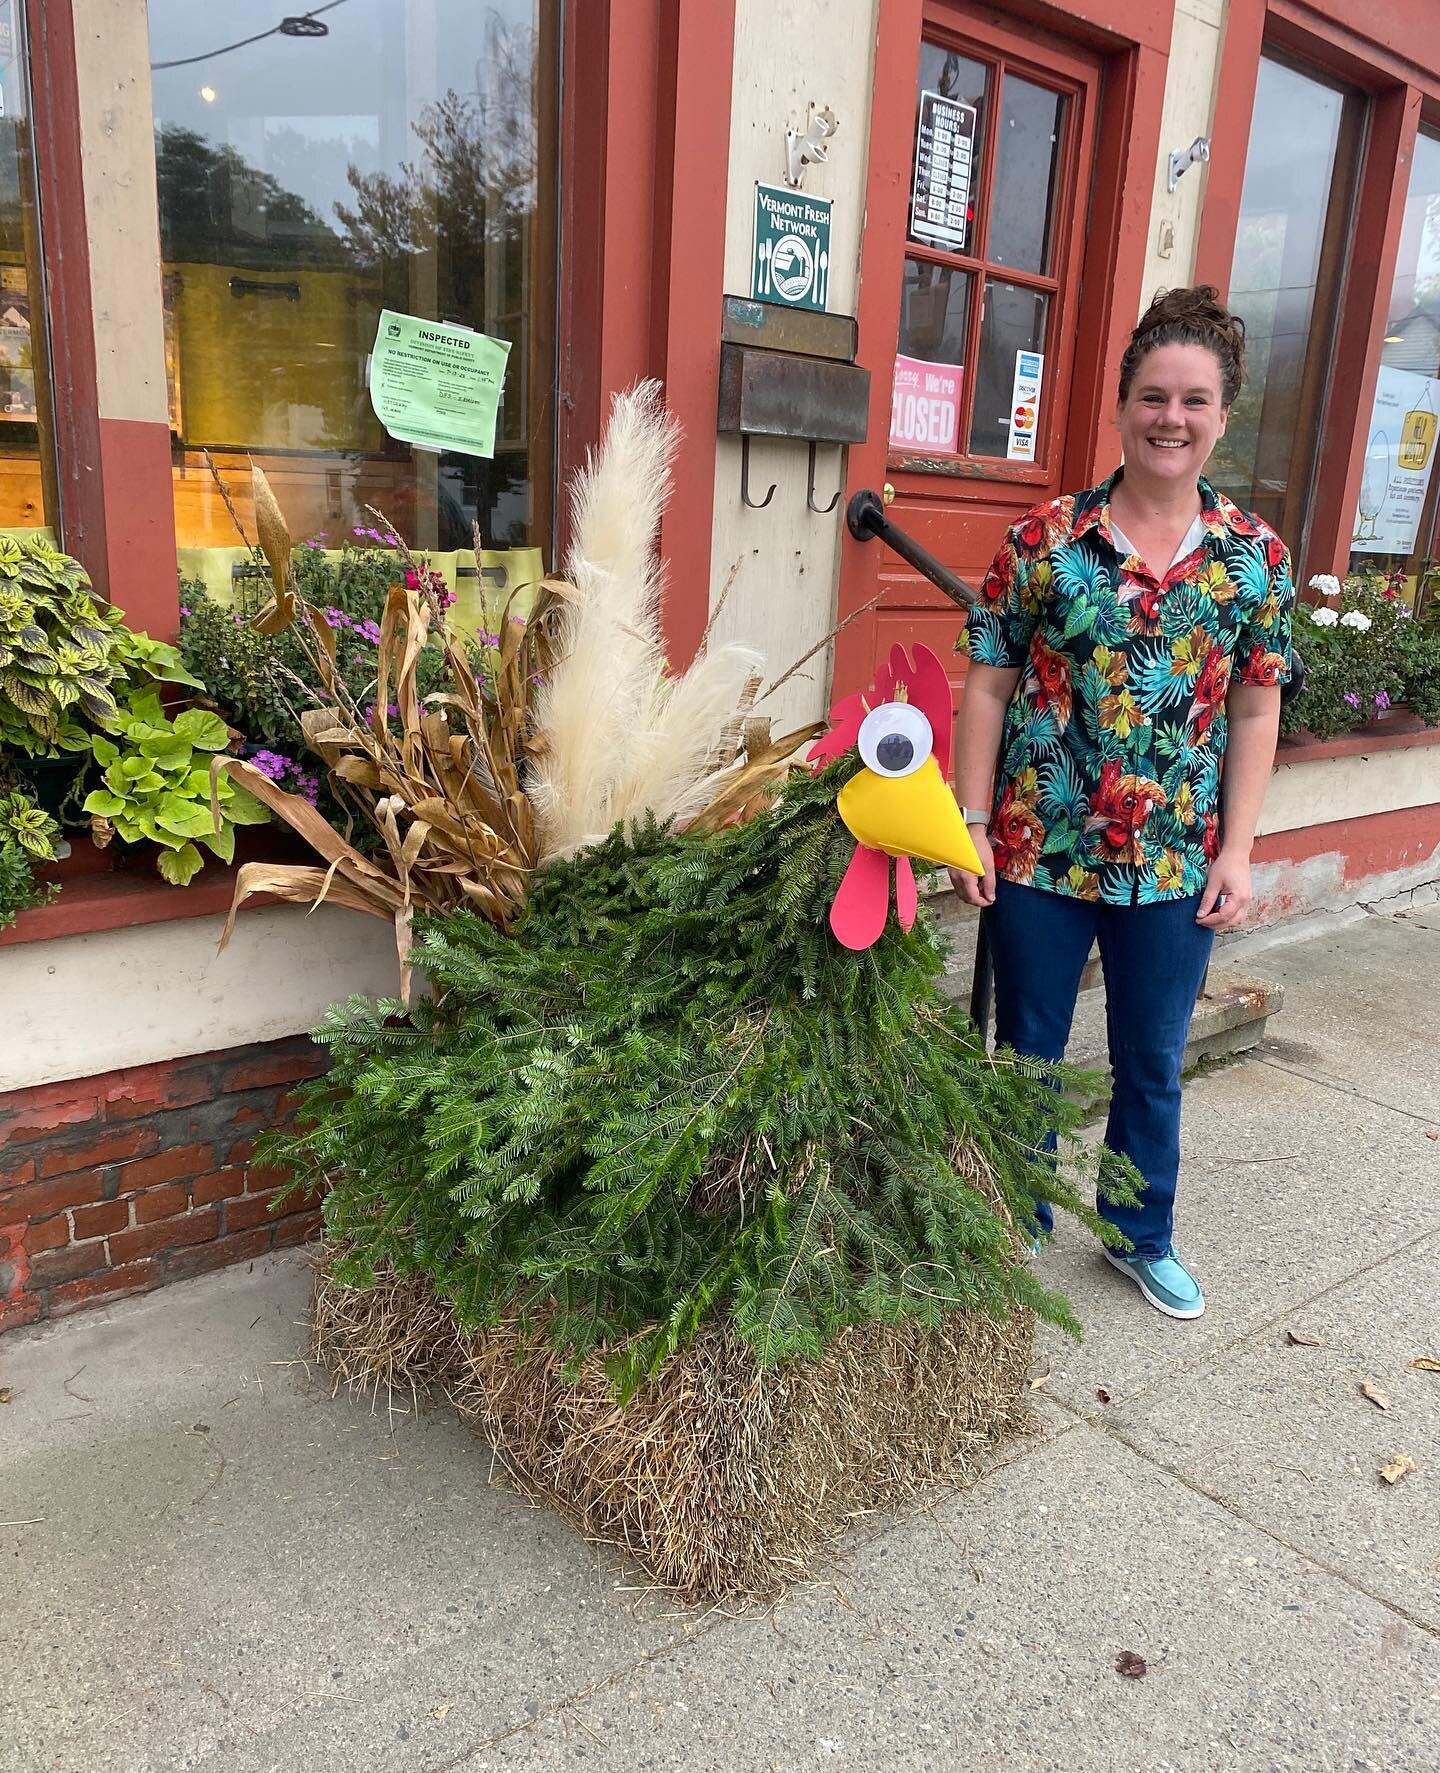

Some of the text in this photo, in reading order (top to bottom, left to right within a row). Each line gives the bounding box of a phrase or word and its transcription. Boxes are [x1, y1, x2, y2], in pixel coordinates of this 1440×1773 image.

[932, 102, 965, 123] BUSINESS
[935, 115, 960, 133] HOURS:
[758, 192, 829, 225] VERMONT FRESH
[770, 212, 818, 238] NETWORK
[418, 330, 470, 349] INSPECTED
[396, 351, 432, 363] RESTRICTION
[460, 366, 490, 377] OCCUPANCY
[925, 373, 955, 394] We're
[1016, 438, 1029, 447] VISA
